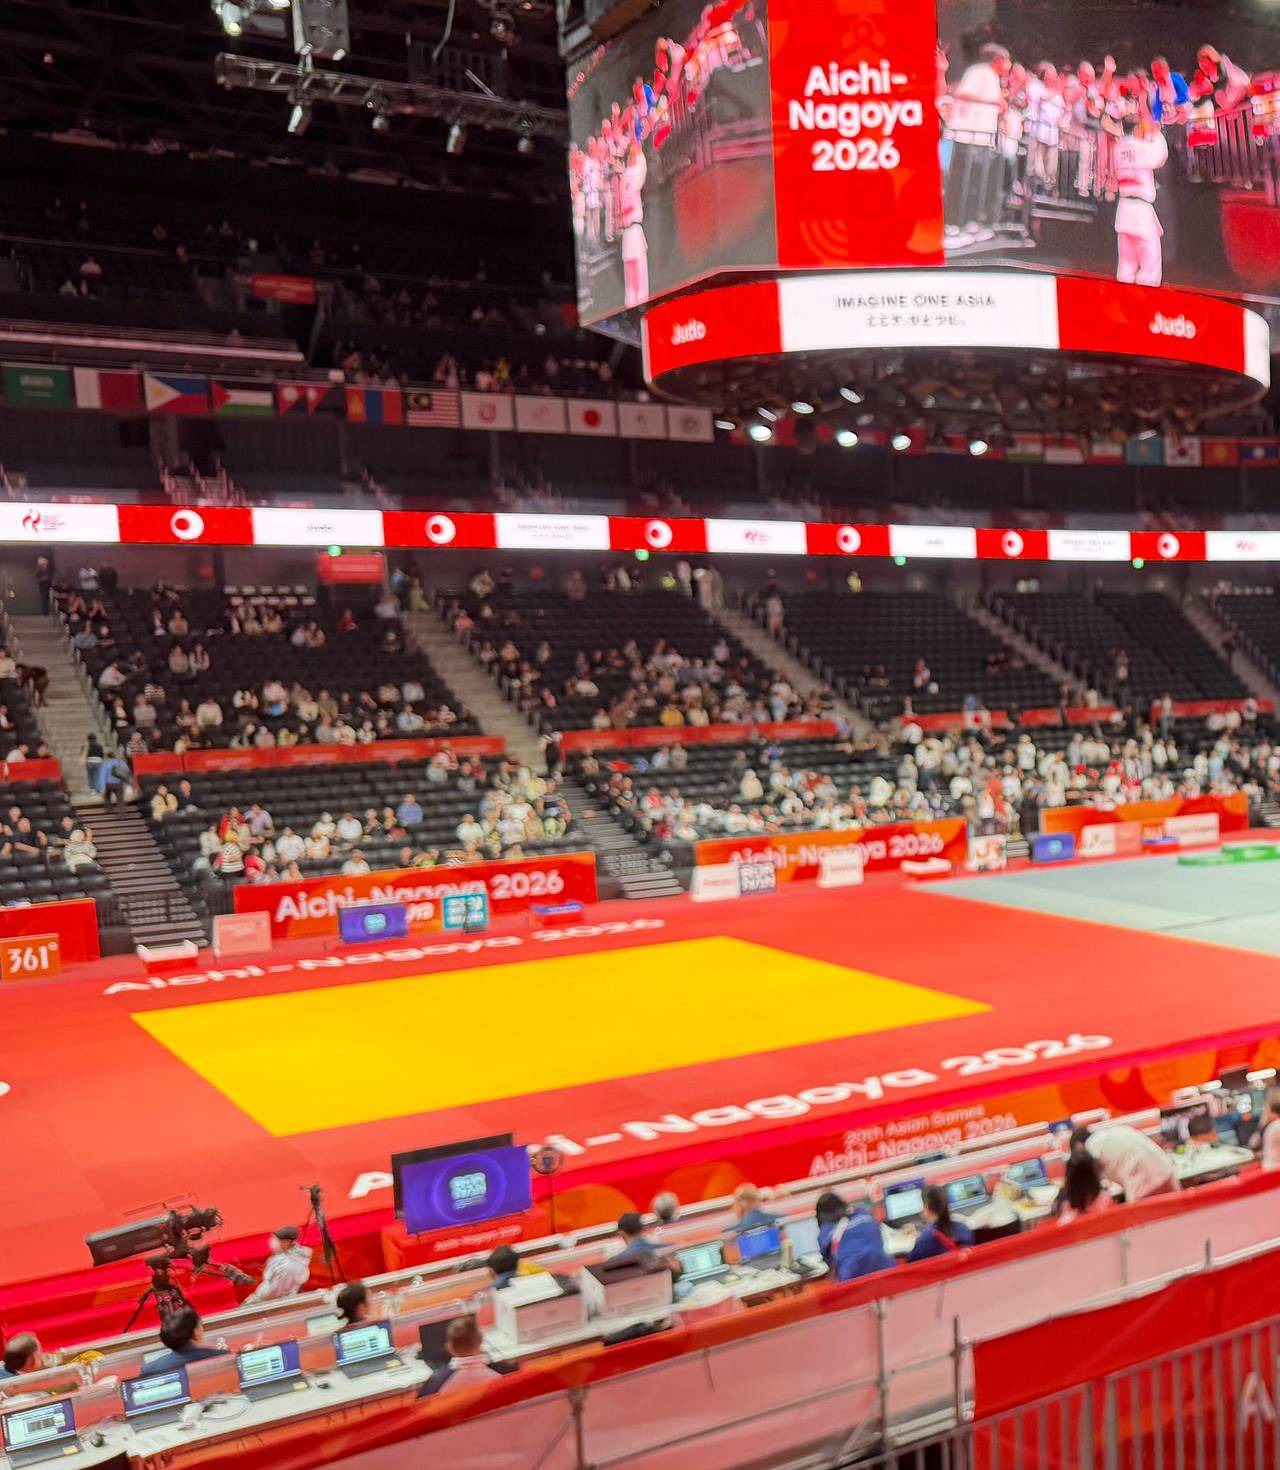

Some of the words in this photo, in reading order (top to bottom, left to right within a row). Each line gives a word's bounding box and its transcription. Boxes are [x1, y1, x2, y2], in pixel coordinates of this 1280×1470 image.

[804, 59, 908, 97] Aichi-
[788, 99, 923, 137] Nagoya
[811, 137, 900, 171] 2026
[836, 294, 908, 309] IMAGINE
[914, 293, 951, 308] ONE
[956, 293, 996, 307] ASIA
[671, 317, 706, 345] Judo
[1149, 311, 1196, 339] Judo
[890, 833, 944, 858] 2026
[491, 870, 564, 899] 2026
[103, 936, 523, 996] Aichi-Nagoya
[531, 919, 666, 943] 2026
[338, 1067, 939, 1201] Ai-Nagoya
[940, 1033, 1113, 1077] 2026
[886, 1114, 930, 1137] Asian
[930, 1104, 985, 1127] Games
